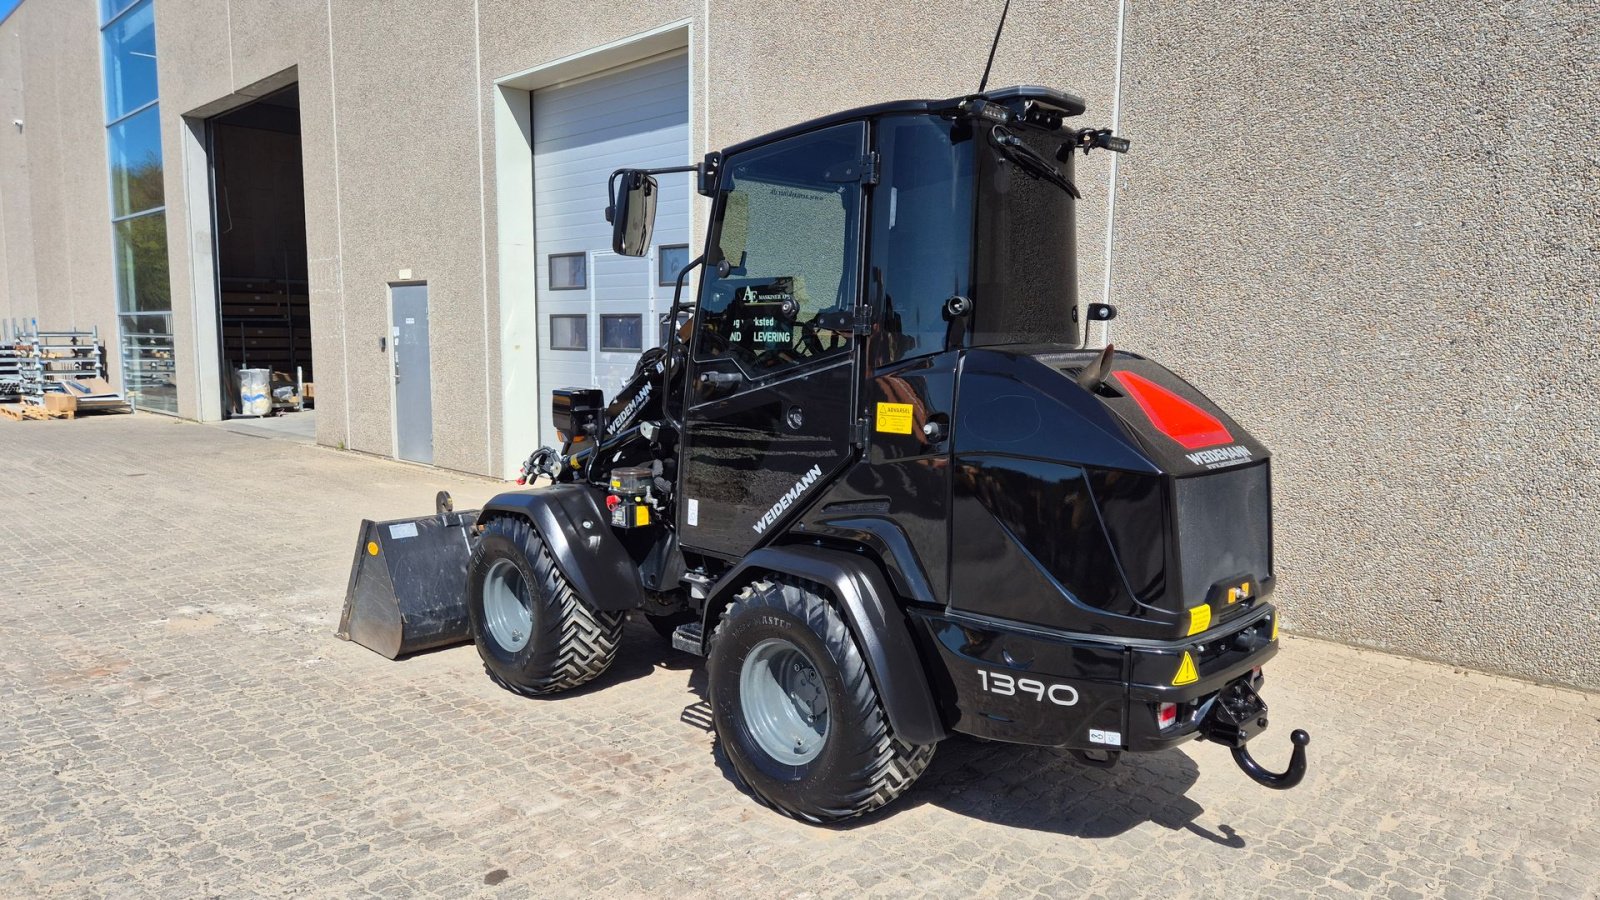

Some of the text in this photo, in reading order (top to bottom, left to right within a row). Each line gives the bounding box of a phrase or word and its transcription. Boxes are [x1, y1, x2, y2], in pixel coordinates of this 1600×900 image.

[753, 331, 790, 342] LEVERING
[606, 380, 653, 435] WEIDEMANN
[1185, 445, 1253, 466] WEIDEMANN
[752, 464, 823, 534] WEIDEMANN
[977, 668, 1079, 707] 1390
